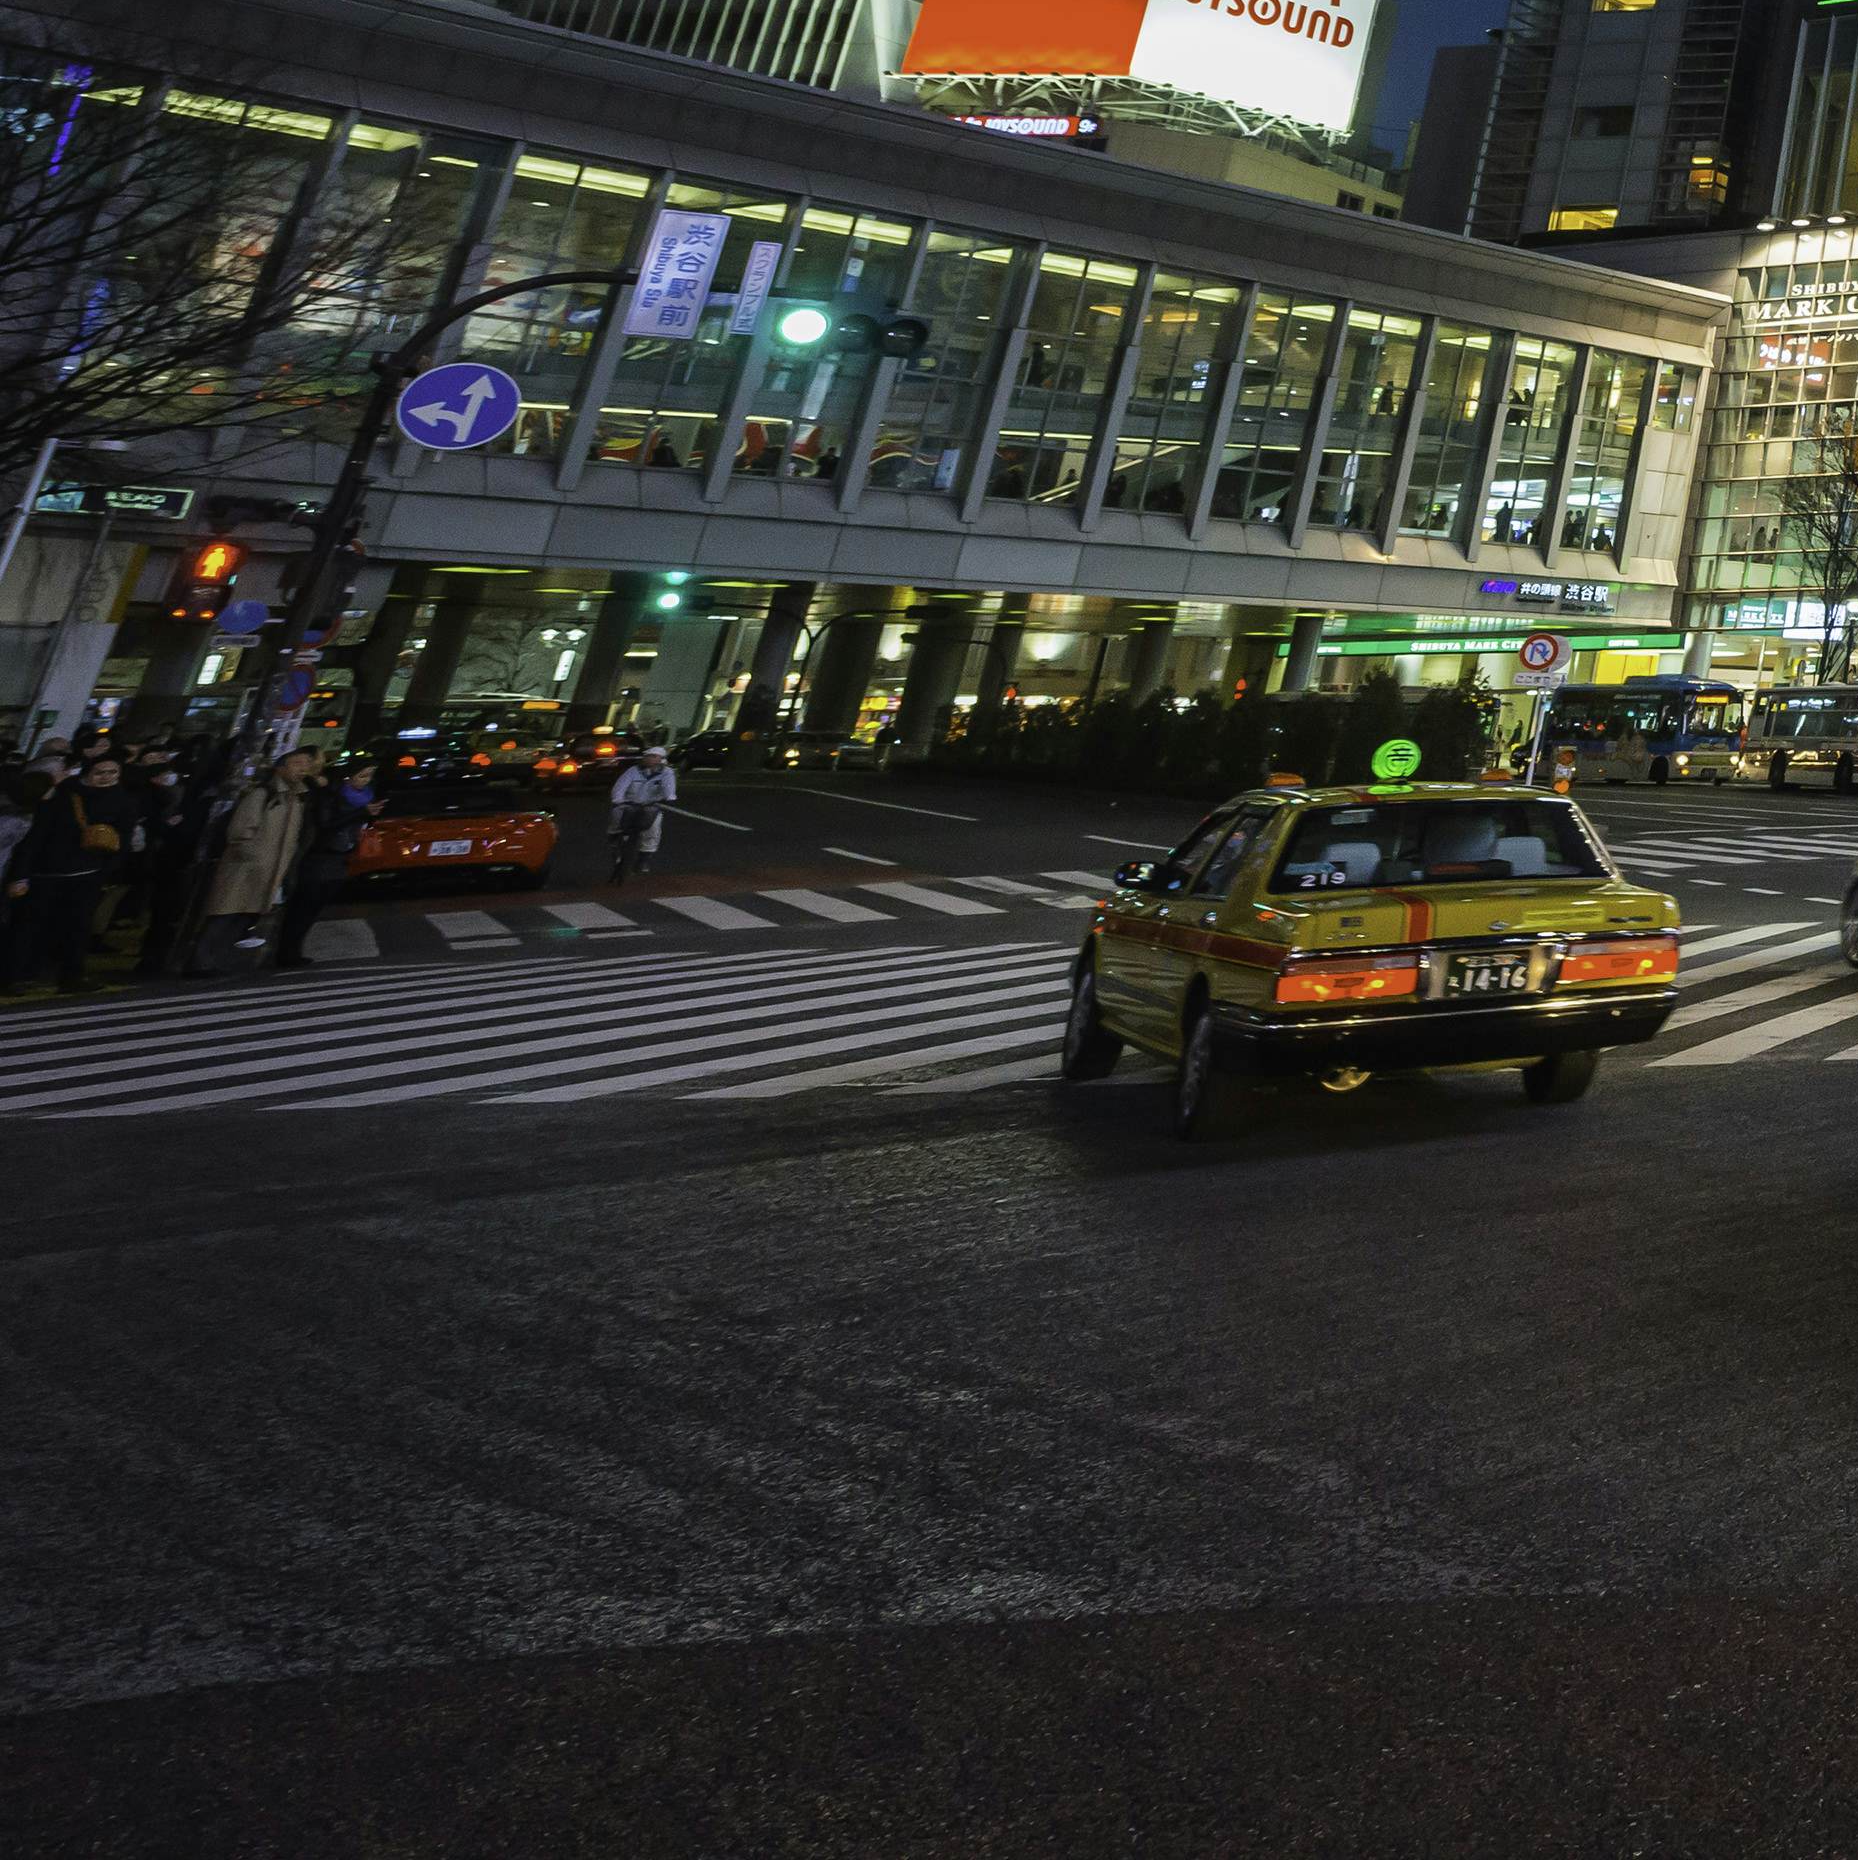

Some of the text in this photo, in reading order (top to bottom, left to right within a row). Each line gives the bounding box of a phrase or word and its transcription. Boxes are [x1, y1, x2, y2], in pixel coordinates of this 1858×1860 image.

[985, 117, 1071, 136] JOYSOUND
[649, 236, 678, 285] Shibuya
[657, 224, 716, 328] 渋谷駅前
[1747, 297, 1834, 322] MARK
[1564, 583, 1609, 603] 渋谷駅
[1410, 640, 1462, 653] SHIBUYA
[1463, 640, 1499, 651] MARK
[1300, 871, 1348, 888] 219
[1463, 965, 1527, 991] 14-16
